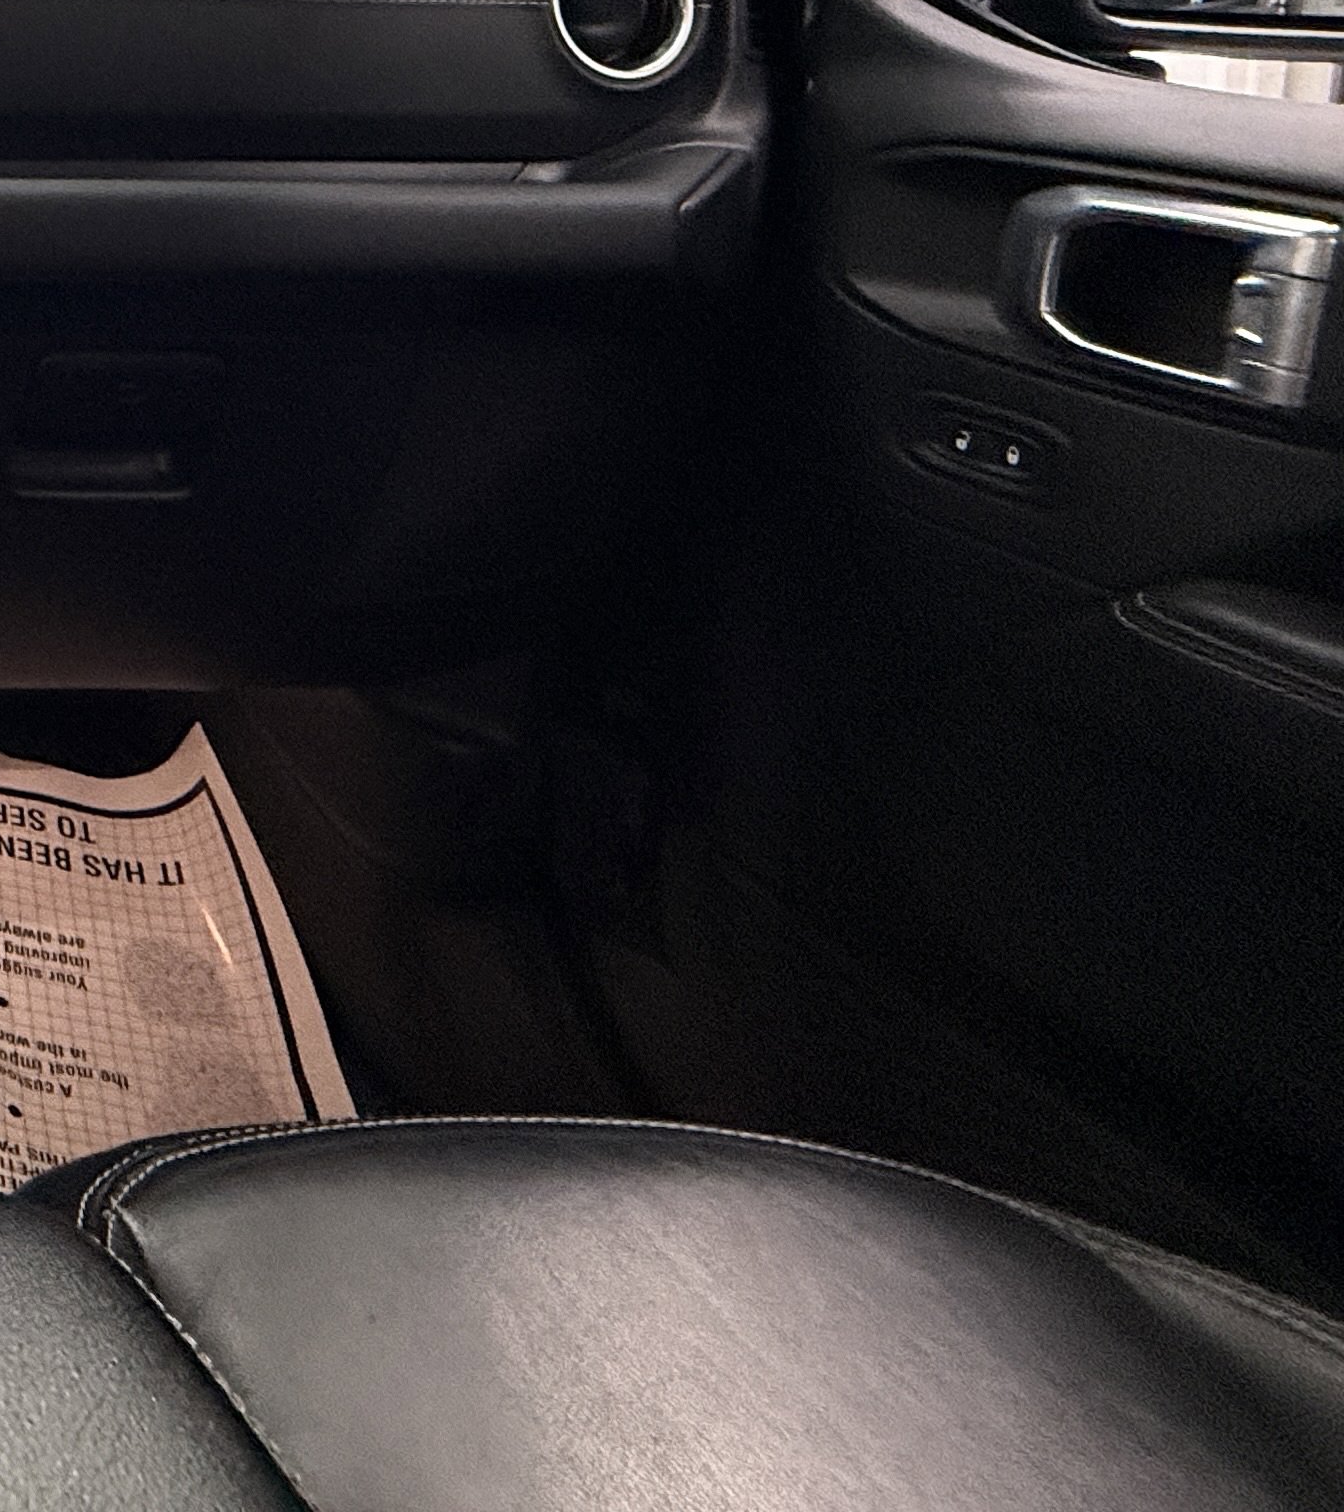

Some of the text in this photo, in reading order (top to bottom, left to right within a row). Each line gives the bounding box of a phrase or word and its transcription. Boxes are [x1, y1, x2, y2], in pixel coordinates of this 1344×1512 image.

[56, 814, 97, 846] TO
[83, 854, 147, 885] HAS
[157, 861, 186, 887] IT
[57, 933, 85, 949] are
[4, 939, 90, 970] improving
[49, 970, 88, 992] Your
[37, 1039, 64, 1058] the
[69, 1047, 87, 1062] in
[48, 1061, 94, 1079] most
[100, 1069, 129, 1091] the
[60, 1083, 73, 1098] A
